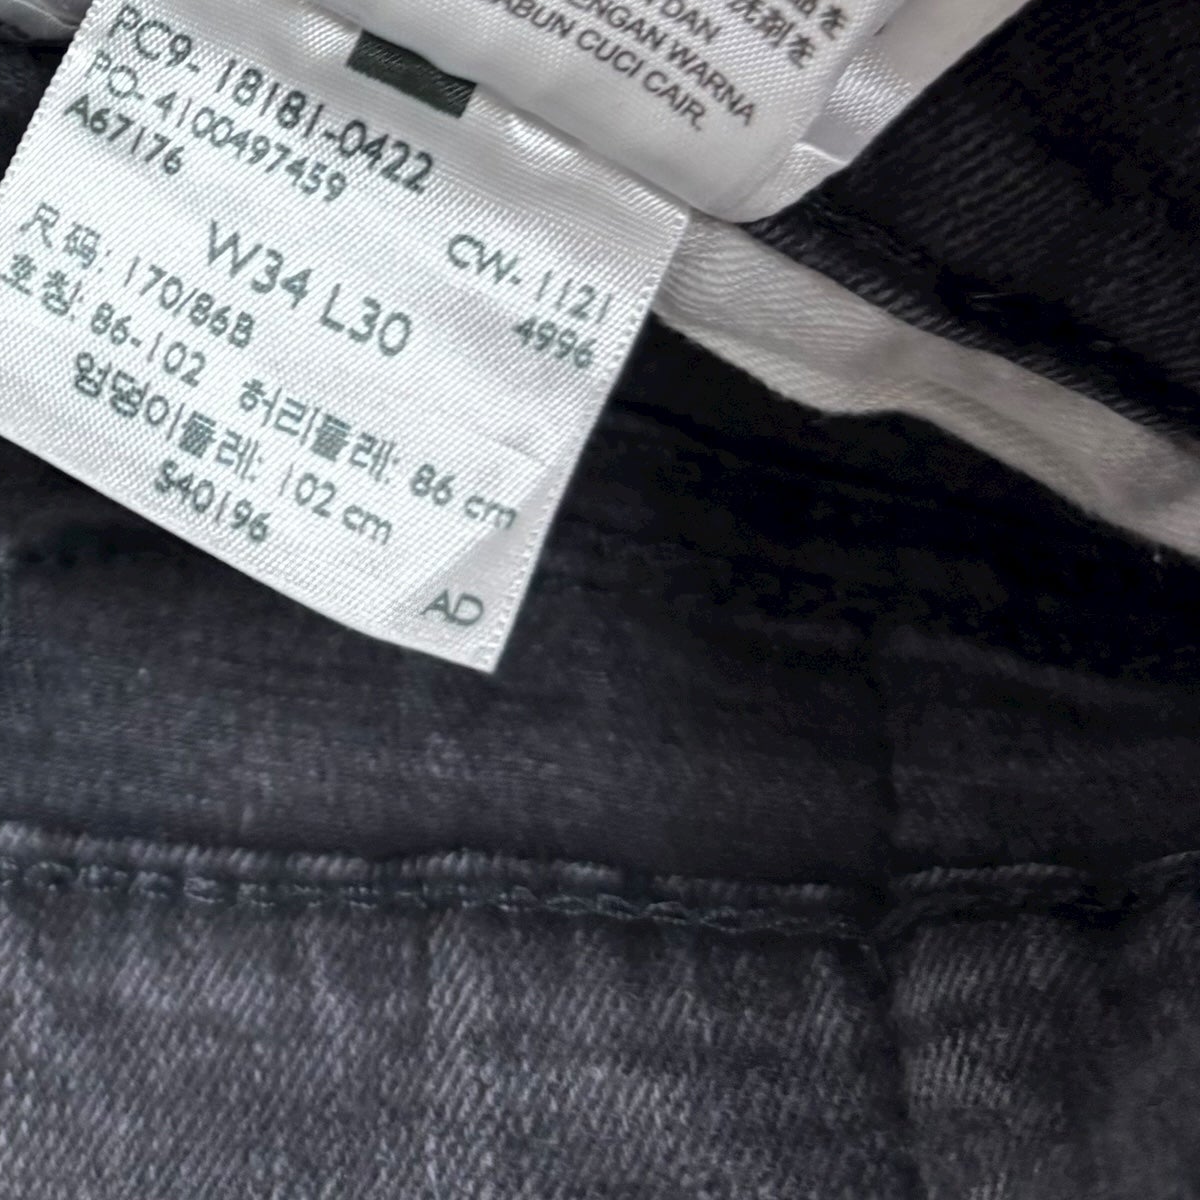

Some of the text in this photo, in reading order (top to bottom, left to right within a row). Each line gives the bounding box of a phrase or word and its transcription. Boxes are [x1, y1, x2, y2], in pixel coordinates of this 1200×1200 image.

[574, 25, 646, 80] CUCI
[670, 39, 754, 128] WARNA
[62, 92, 596, 372] A67176 4996
[122, 256, 256, 351] 170/86B
[204, 218, 412, 360] W34 L30
[86, 301, 211, 388] 86-102
[406, 461, 457, 509] 86
[460, 493, 518, 531] cm
[151, 458, 269, 544] S40196
[277, 463, 338, 518] 102
[338, 503, 394, 546] cm
[420, 589, 483, 628] AD
